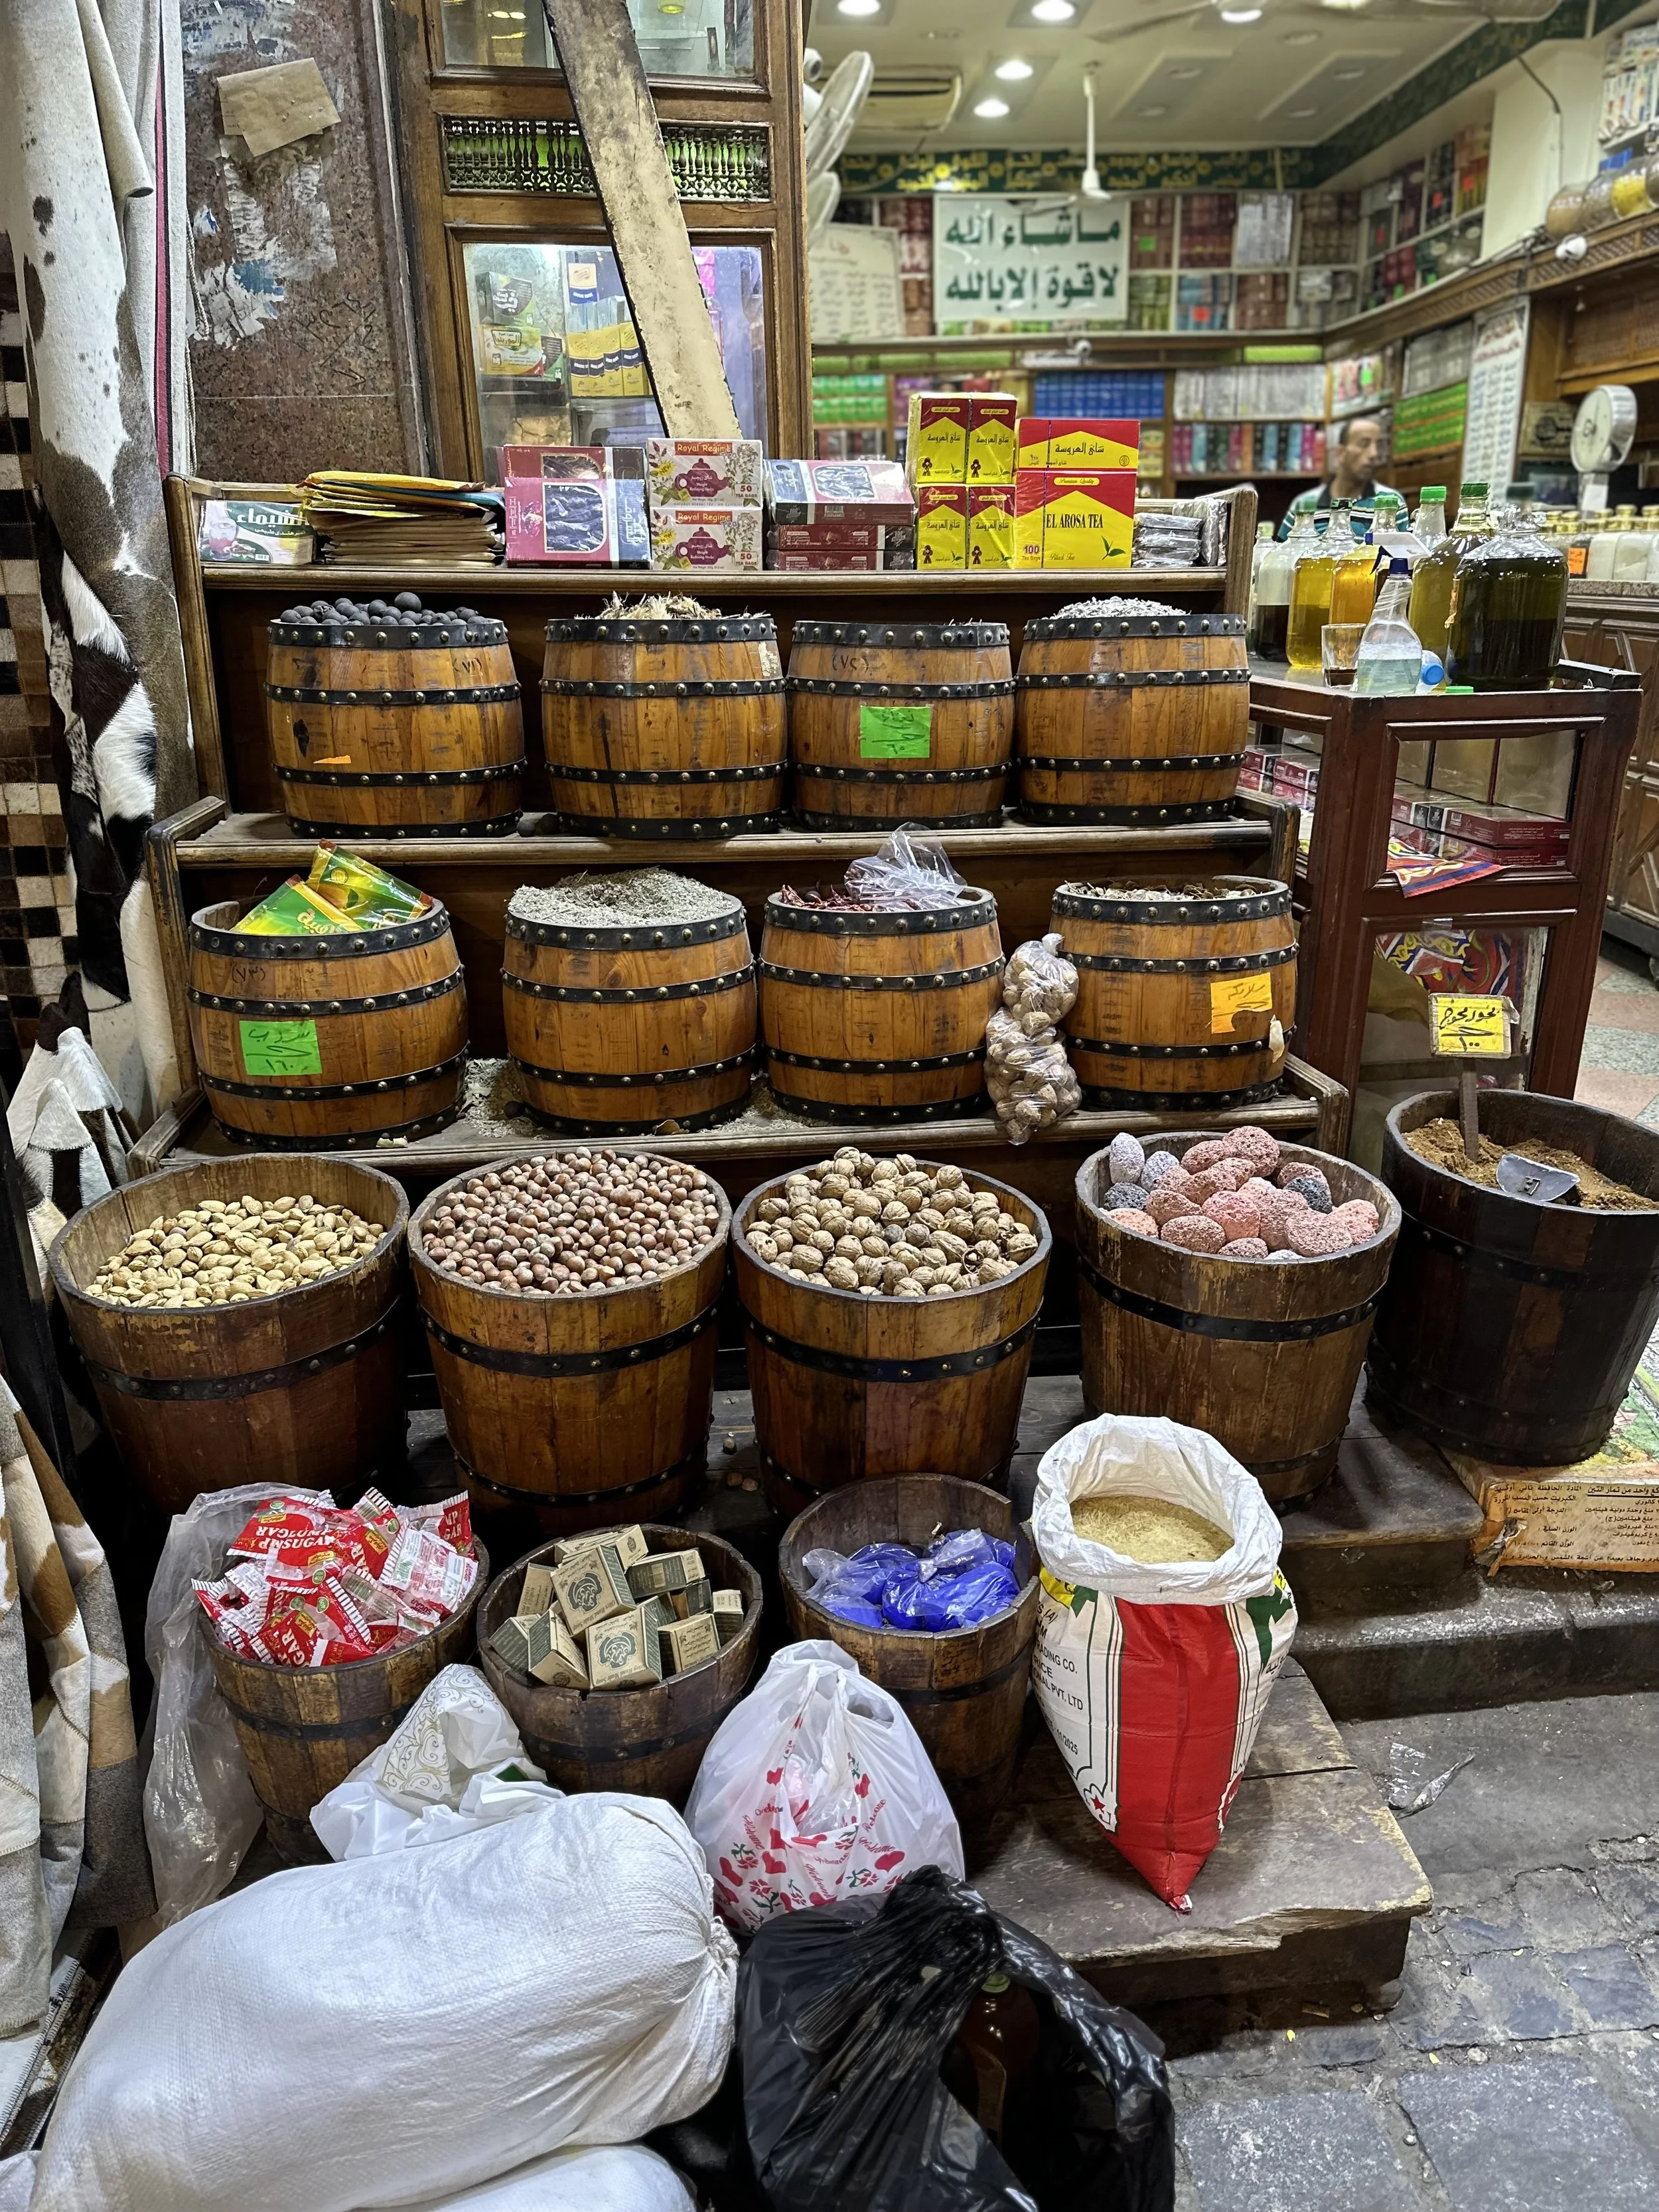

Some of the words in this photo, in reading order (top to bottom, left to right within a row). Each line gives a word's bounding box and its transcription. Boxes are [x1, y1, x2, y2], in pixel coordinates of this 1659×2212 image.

[945, 207, 993, 245] الله
[946, 267, 1004, 312] بالله
[927, 432, 949, 443] العروسة
[976, 434, 997, 445] العروسة
[677, 444, 699, 453] Royal
[702, 444, 731, 453] Regime
[1055, 443, 1086, 455] العروسة
[659, 463, 671, 474] NEW
[678, 513, 699, 522] Royal
[703, 513, 731, 522] Regime
[1046, 514, 1057, 528] EL
[1060, 514, 1086, 528] AROSA
[1088, 514, 1104, 528] TEA
[721, 520, 738, 529] Tea
[1024, 544, 1039, 554] 100
[1037, 1639, 1061, 1666] RADING
[1062, 1659, 1078, 1674] CO.
[1033, 1655, 1054, 1678] RICE
[1051, 1683, 1067, 1702] PVT.
[1068, 1693, 1083, 1710] LTD
[1056, 1728, 1079, 1755] 11/2025
